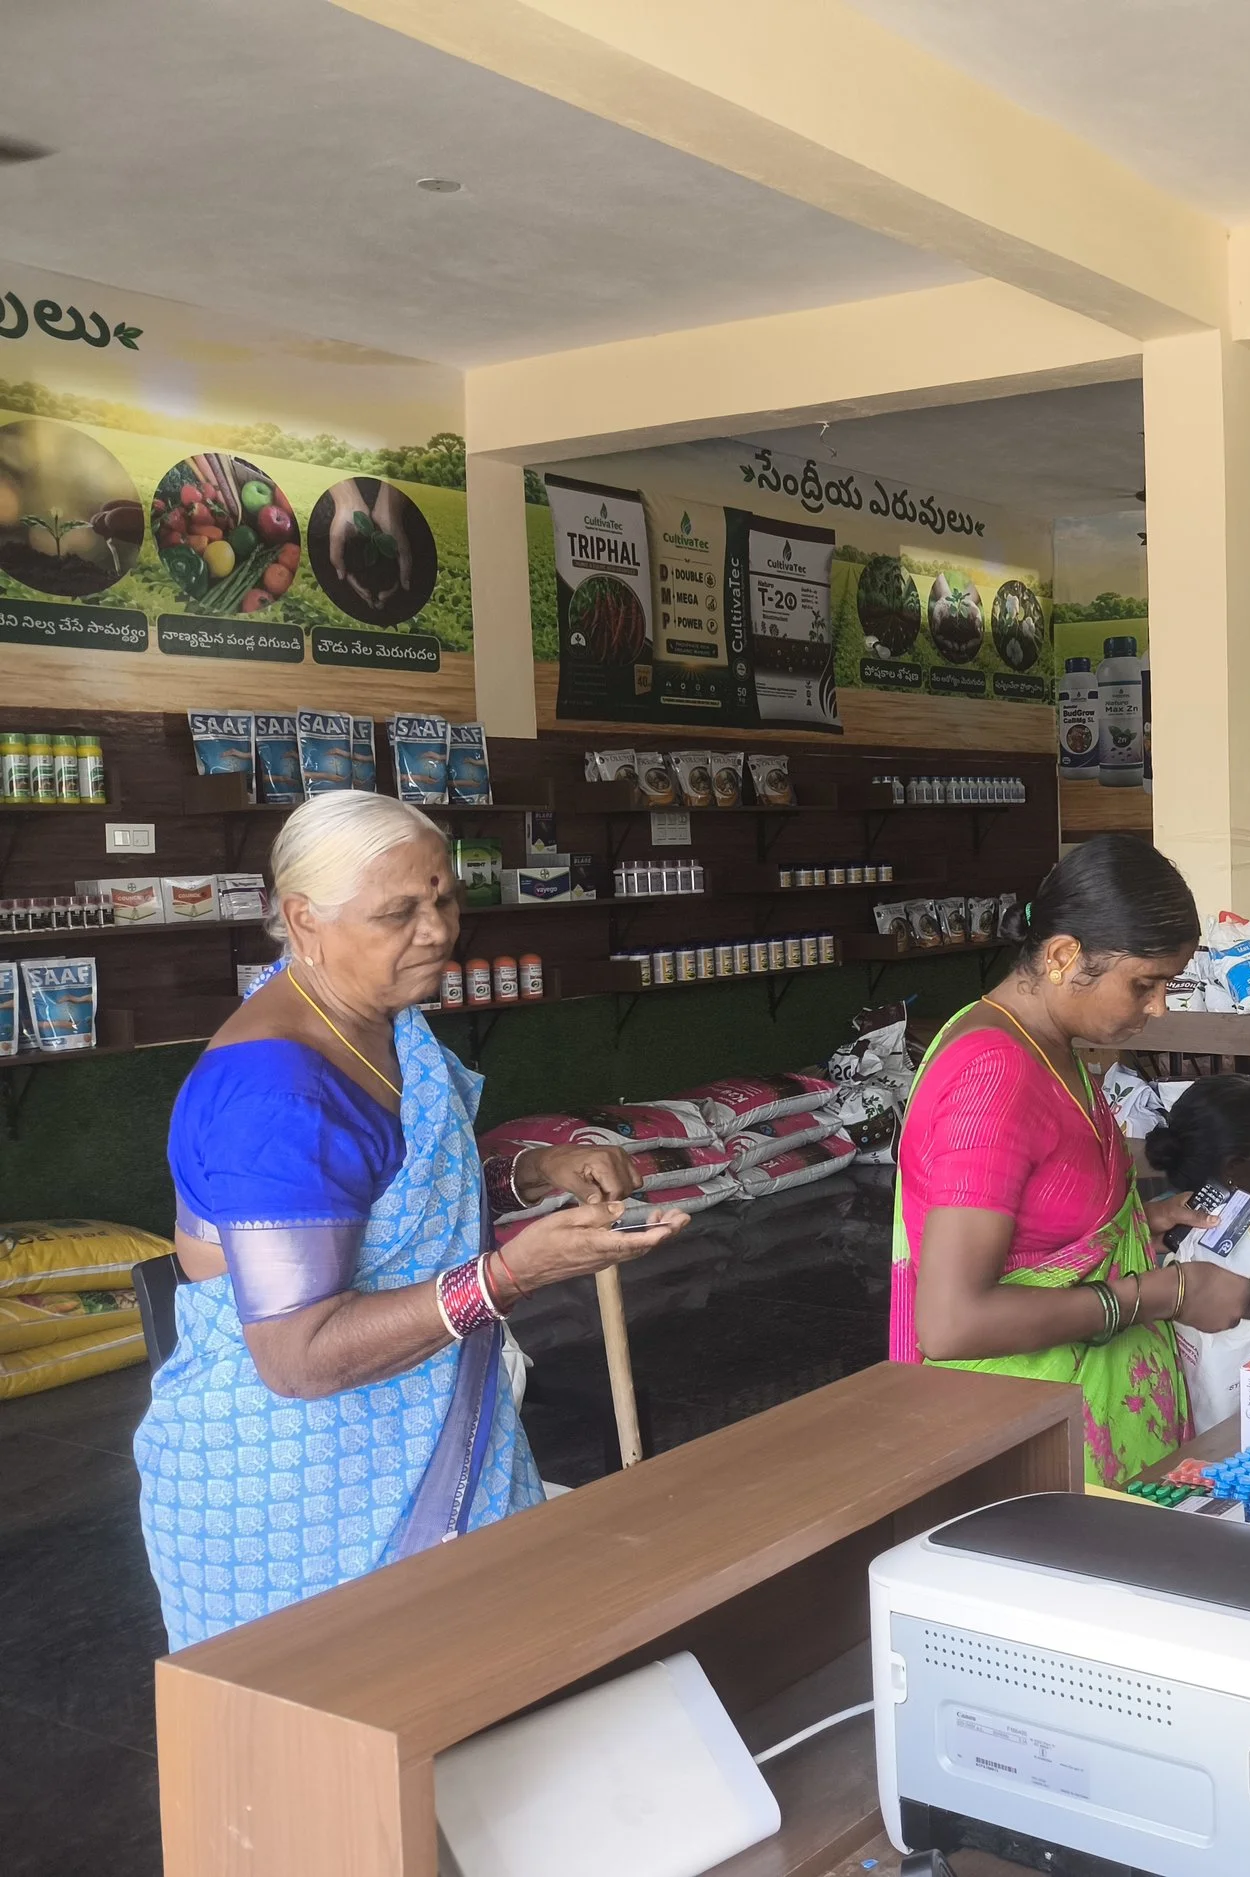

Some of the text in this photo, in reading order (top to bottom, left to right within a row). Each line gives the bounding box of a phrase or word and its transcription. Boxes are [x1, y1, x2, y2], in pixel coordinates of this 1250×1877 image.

[868, 479, 974, 536] ఎరువులు
[583, 515, 623, 532] CultivaTec
[566, 532, 641, 567] TRIPHAL
[663, 532, 709, 549] CultivaTec
[767, 558, 807, 574] CultivaTec
[675, 567, 704, 584] DOUBLE
[676, 593, 699, 606] MEGA
[728, 556, 743, 654] CultivaTec
[758, 587, 797, 611] T-20
[22, 615, 56, 635] నిల్వ
[59, 617, 84, 632] చేసే
[677, 618, 703, 630] POWER
[162, 630, 225, 649] నాణ్యమైన
[258, 637, 301, 650] దిగుబడి
[351, 640, 373, 656] నేల
[375, 645, 437, 661] మెరుగుదల
[1126, 705, 1138, 713] Zn
[192, 713, 249, 735] SAAF
[256, 716, 297, 735] SAA
[398, 719, 446, 737] SAAF
[451, 727, 482, 744] AAF
[536, 886, 558, 895] vayego
[31, 968, 90, 987] SAAF
